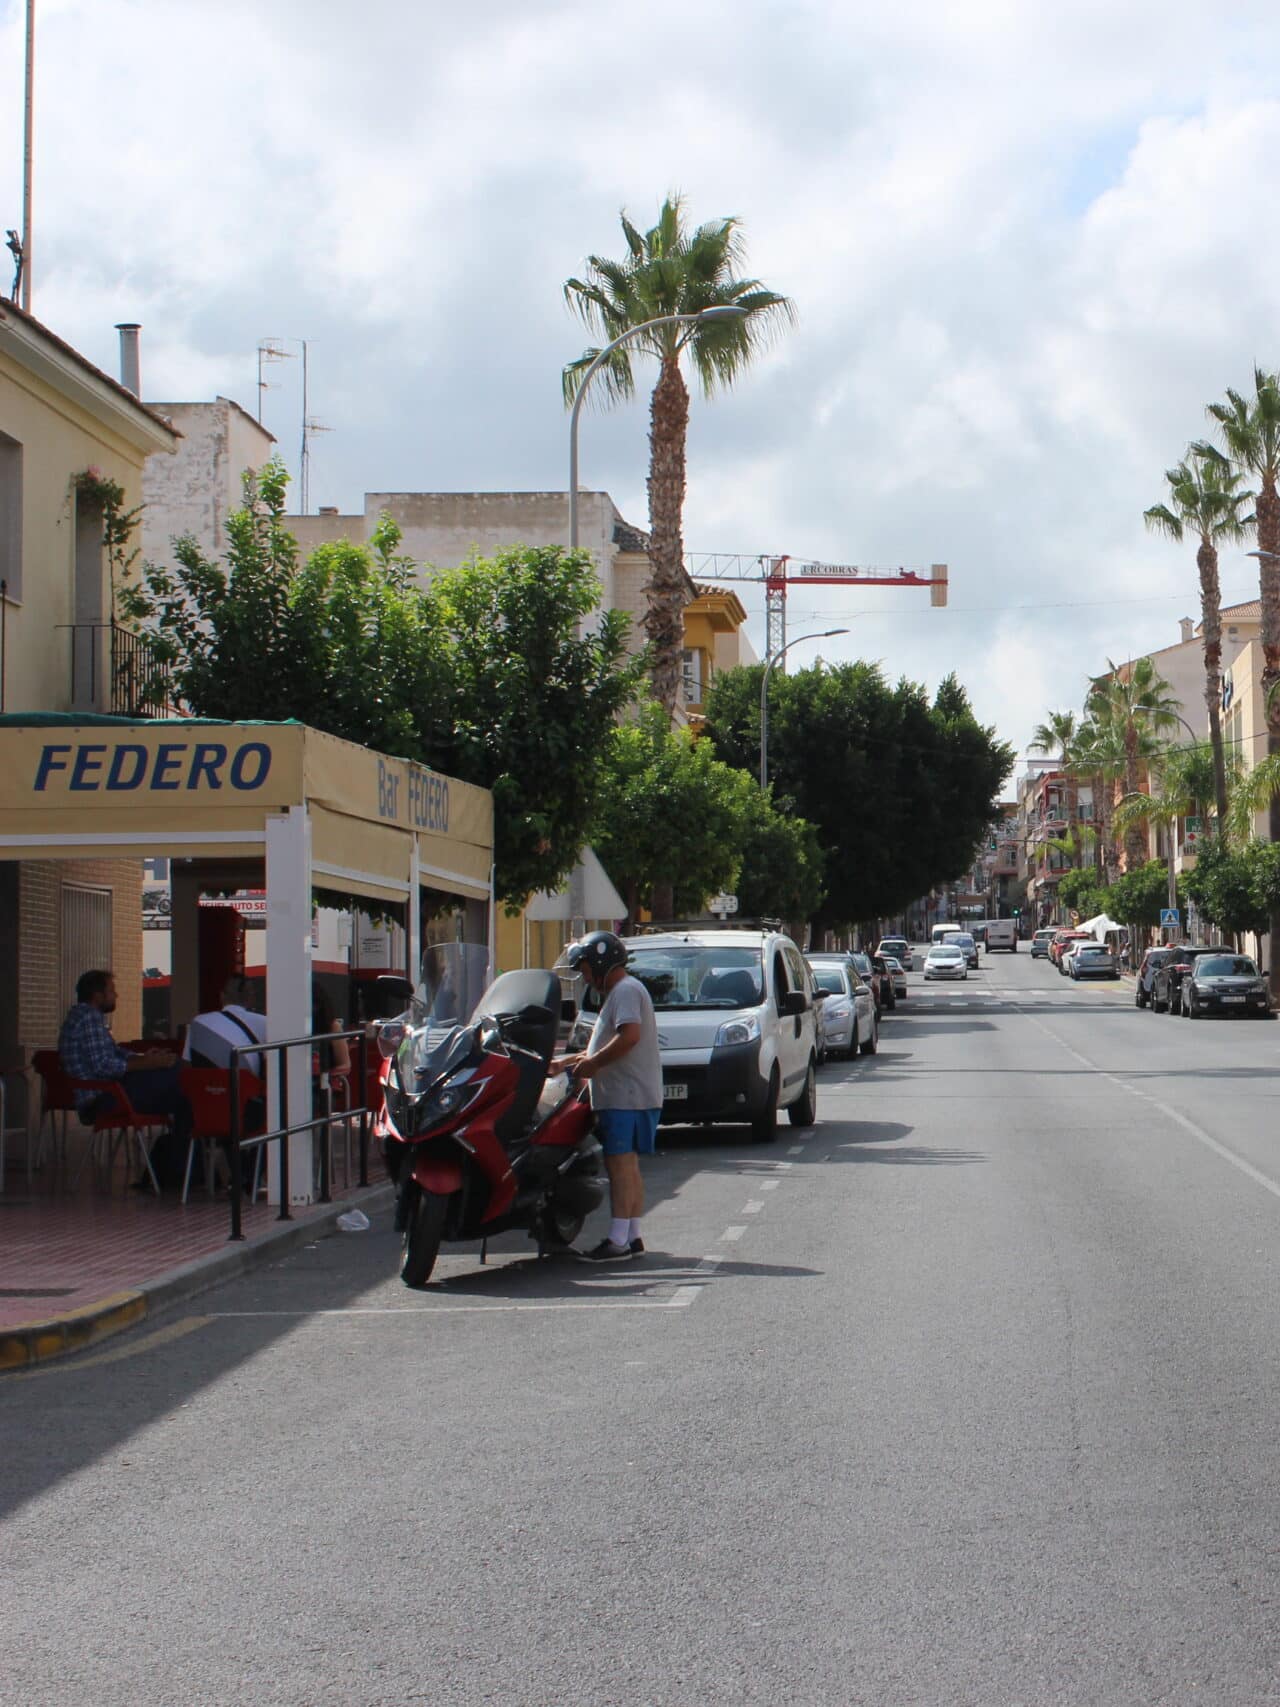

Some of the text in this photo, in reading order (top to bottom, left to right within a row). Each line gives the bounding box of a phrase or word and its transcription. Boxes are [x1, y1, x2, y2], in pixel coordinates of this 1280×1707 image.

[33, 742, 272, 791] FEDERO
[378, 759, 448, 832] Bar FEDERO
[254, 901, 267, 911] SE
